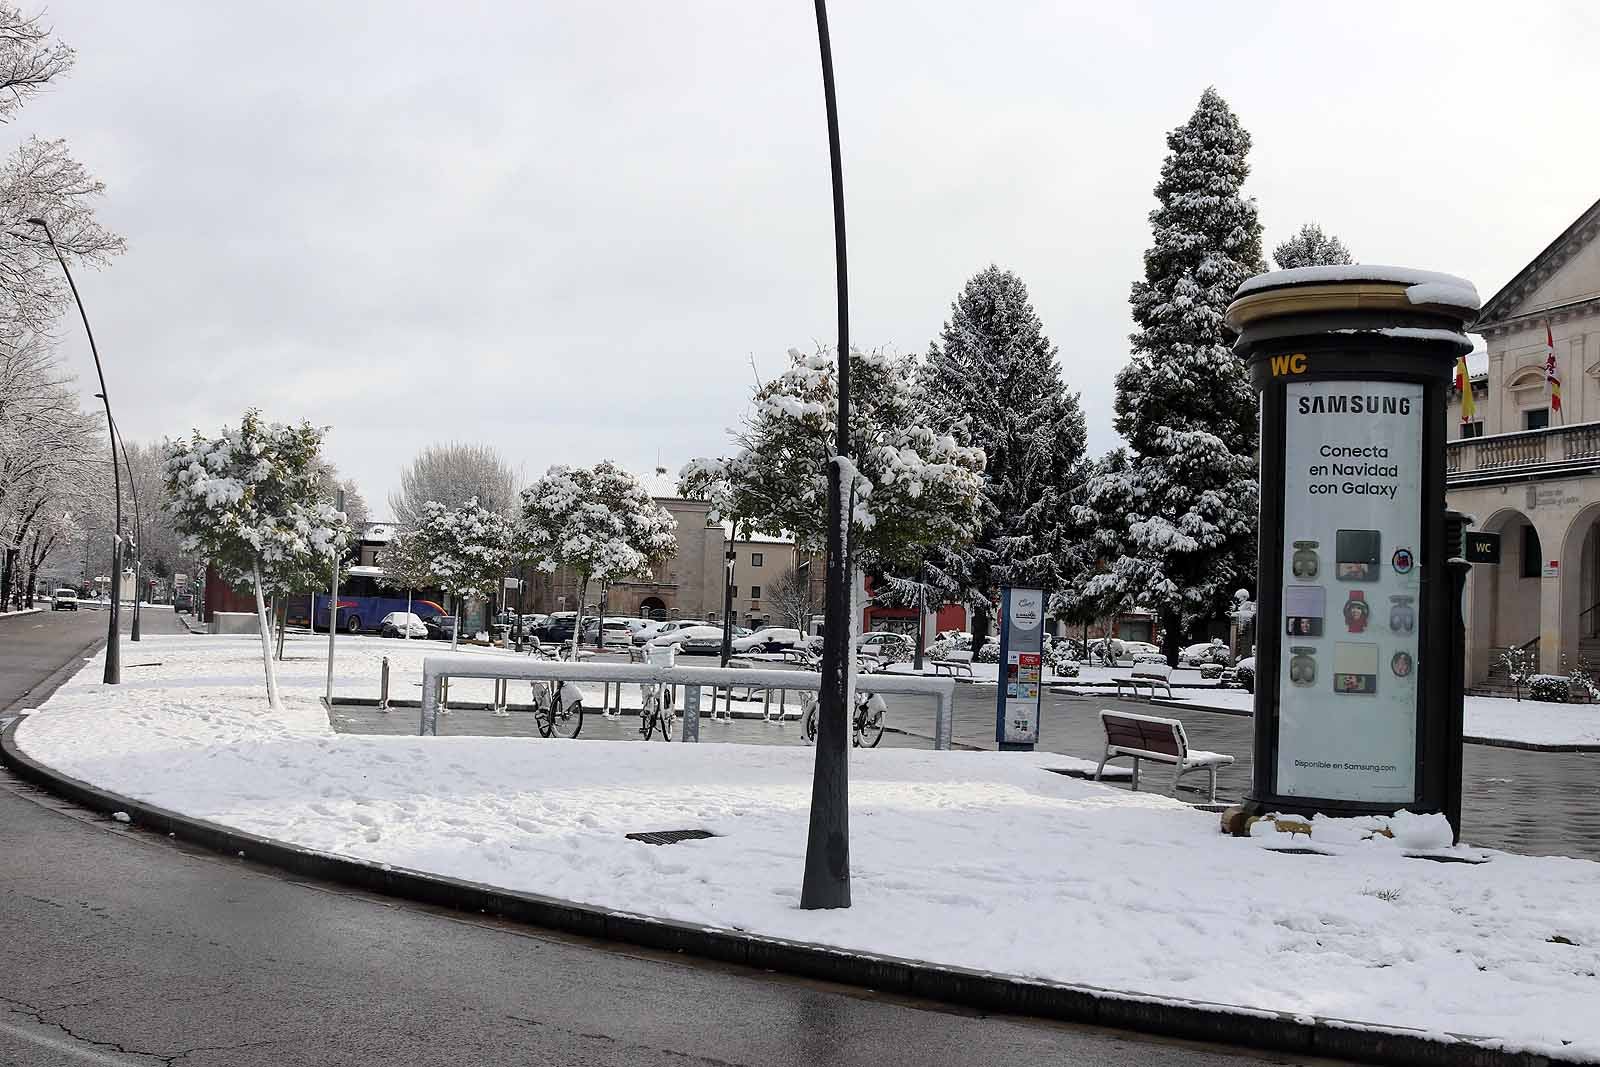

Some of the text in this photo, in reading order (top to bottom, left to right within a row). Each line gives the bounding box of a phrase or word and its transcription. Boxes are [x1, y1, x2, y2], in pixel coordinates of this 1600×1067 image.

[1271, 353, 1307, 376] WC
[1299, 395, 1410, 415] SAMSUNG
[1319, 445, 1388, 458] Conecta
[1309, 463, 1398, 477] en Navidad
[1309, 482, 1398, 499] con Galaxy
[1476, 543, 1491, 553] WC
[1294, 759, 1331, 769] Disponible
[1344, 763, 1396, 773] Samsung.com
